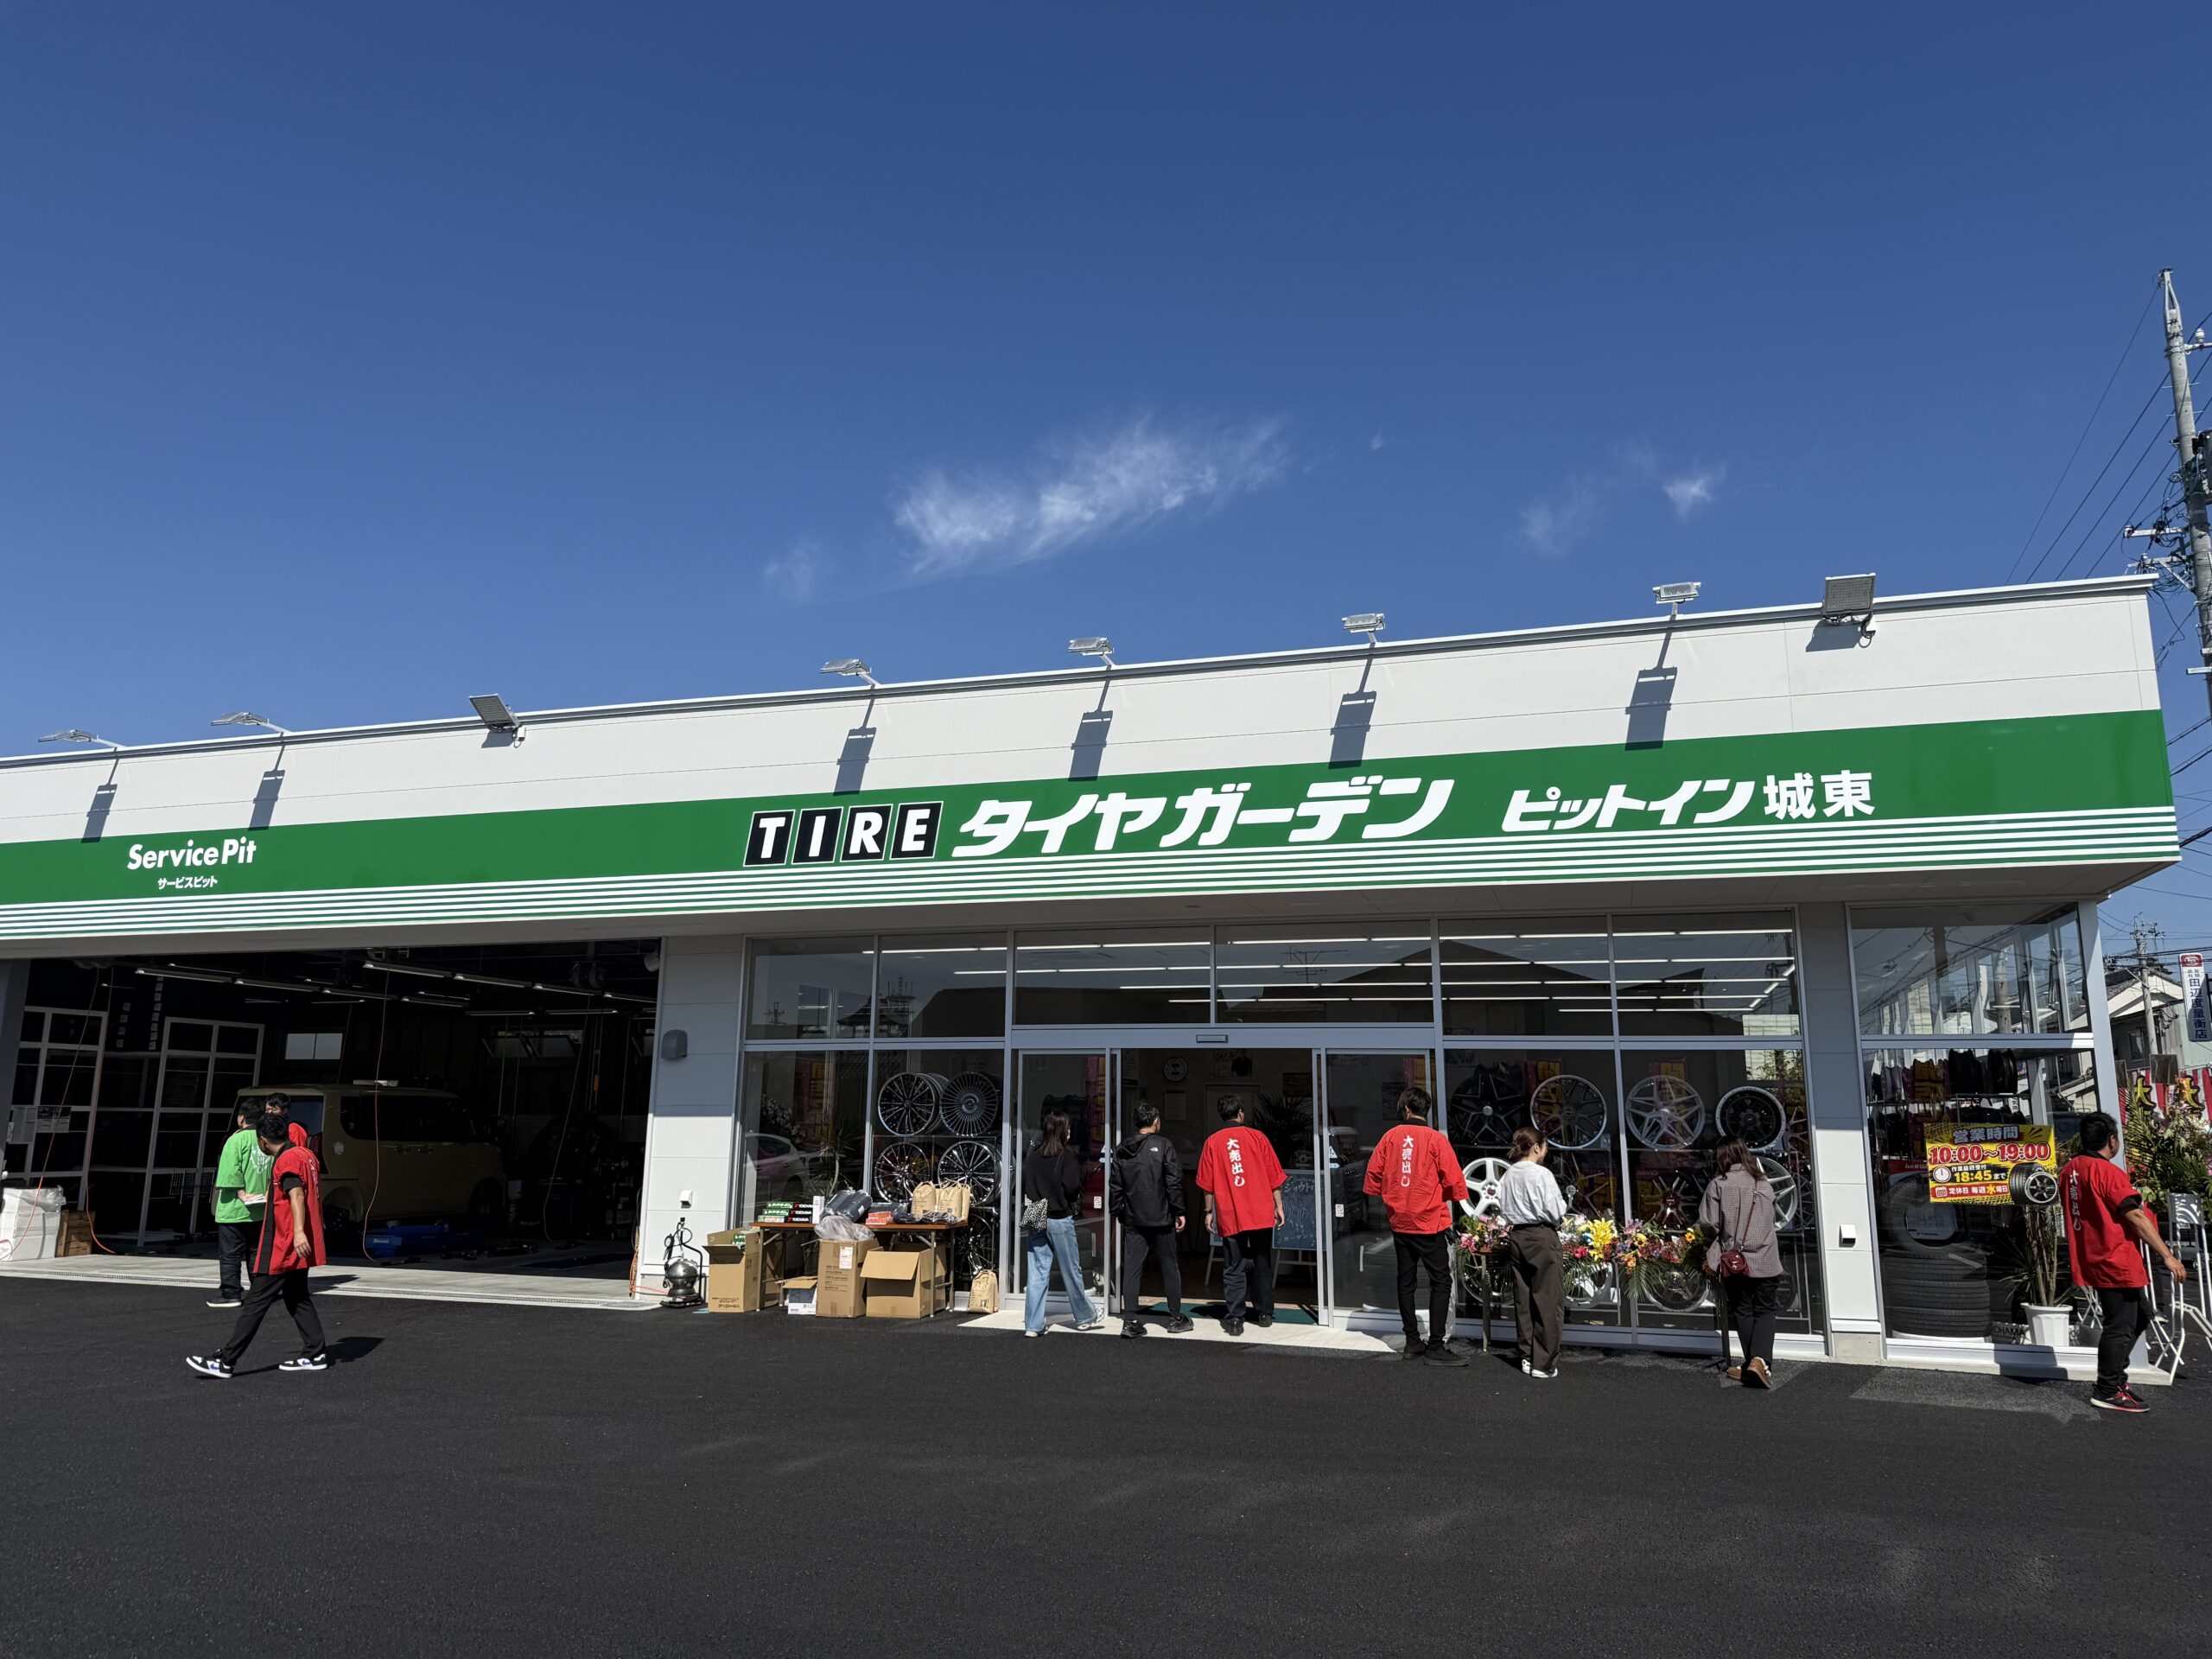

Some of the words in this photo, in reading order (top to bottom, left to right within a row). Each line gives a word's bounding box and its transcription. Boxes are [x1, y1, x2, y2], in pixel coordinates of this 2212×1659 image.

[758, 804, 931, 859] TIRE
[950, 775, 1455, 858] タイヤガーデン
[157, 874, 219, 890] サービスピット
[1953, 1125, 2019, 1143] 営業時間
[1227, 1138, 1245, 1187] 大売出し
[1401, 1135, 1414, 1187] 大売出し
